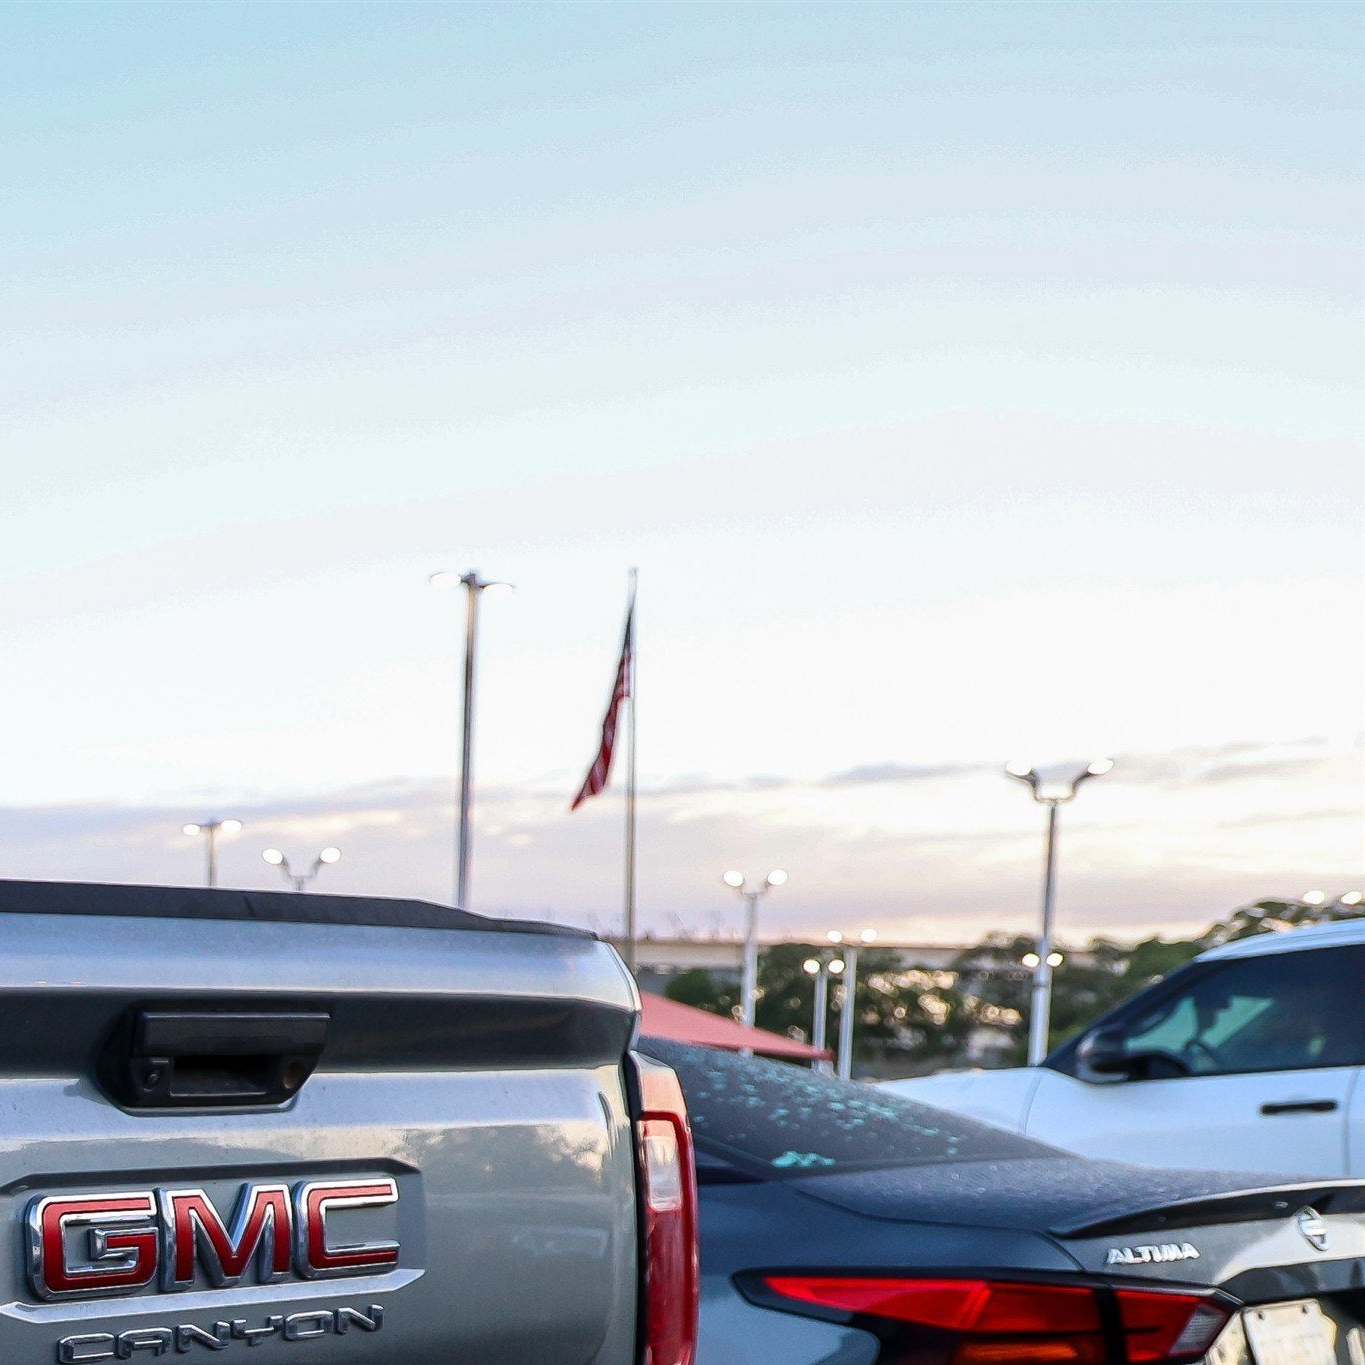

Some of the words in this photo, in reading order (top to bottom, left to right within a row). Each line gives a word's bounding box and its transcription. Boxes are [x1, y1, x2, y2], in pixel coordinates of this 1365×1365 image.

[25, 1177, 401, 1301] GMC
[1106, 1242, 1201, 1265] ALTIMA
[57, 1304, 385, 1365] CANYON
